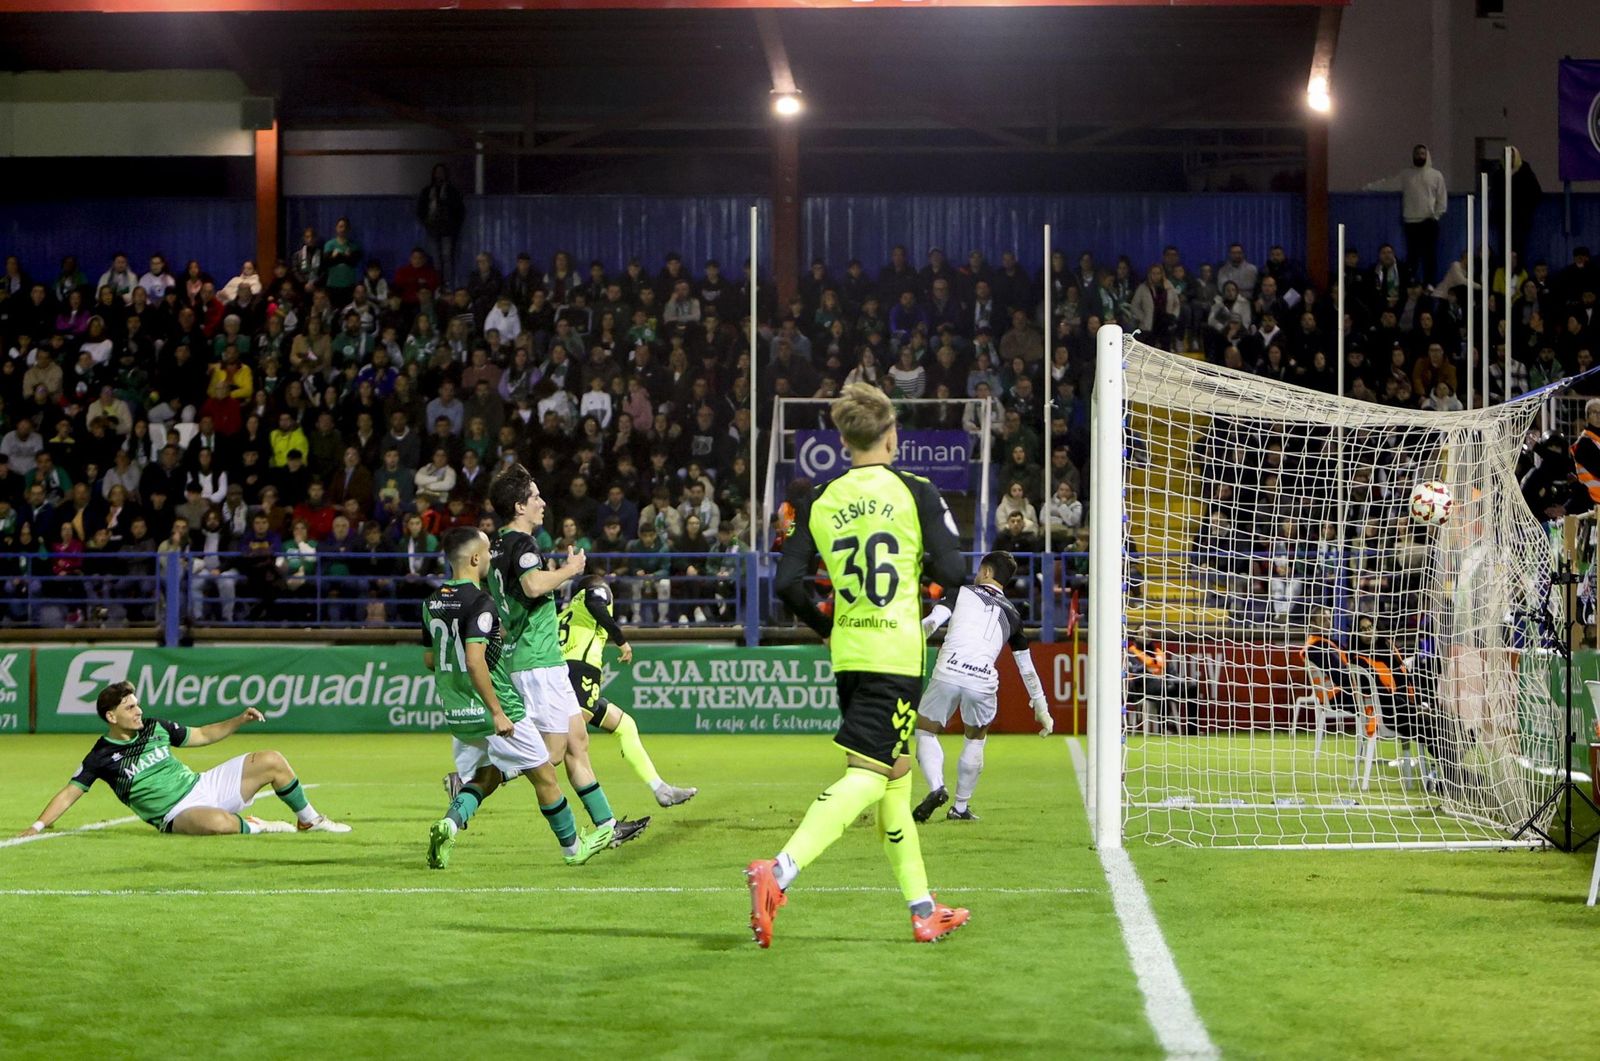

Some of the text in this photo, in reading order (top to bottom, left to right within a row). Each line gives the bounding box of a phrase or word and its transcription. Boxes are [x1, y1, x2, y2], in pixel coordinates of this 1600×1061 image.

[831, 496, 895, 530] JESÚS R.
[831, 531, 899, 608] 36
[429, 618, 468, 673] 21
[632, 660, 837, 684] CAJA RURAL D
[136, 661, 441, 718] Mercoguadian
[591, 682, 600, 701] 8
[388, 706, 446, 730] Grup
[451, 698, 486, 717] moska
[716, 714, 745, 734] caja
[750, 714, 767, 730] de
[773, 713, 843, 731] Extremad
